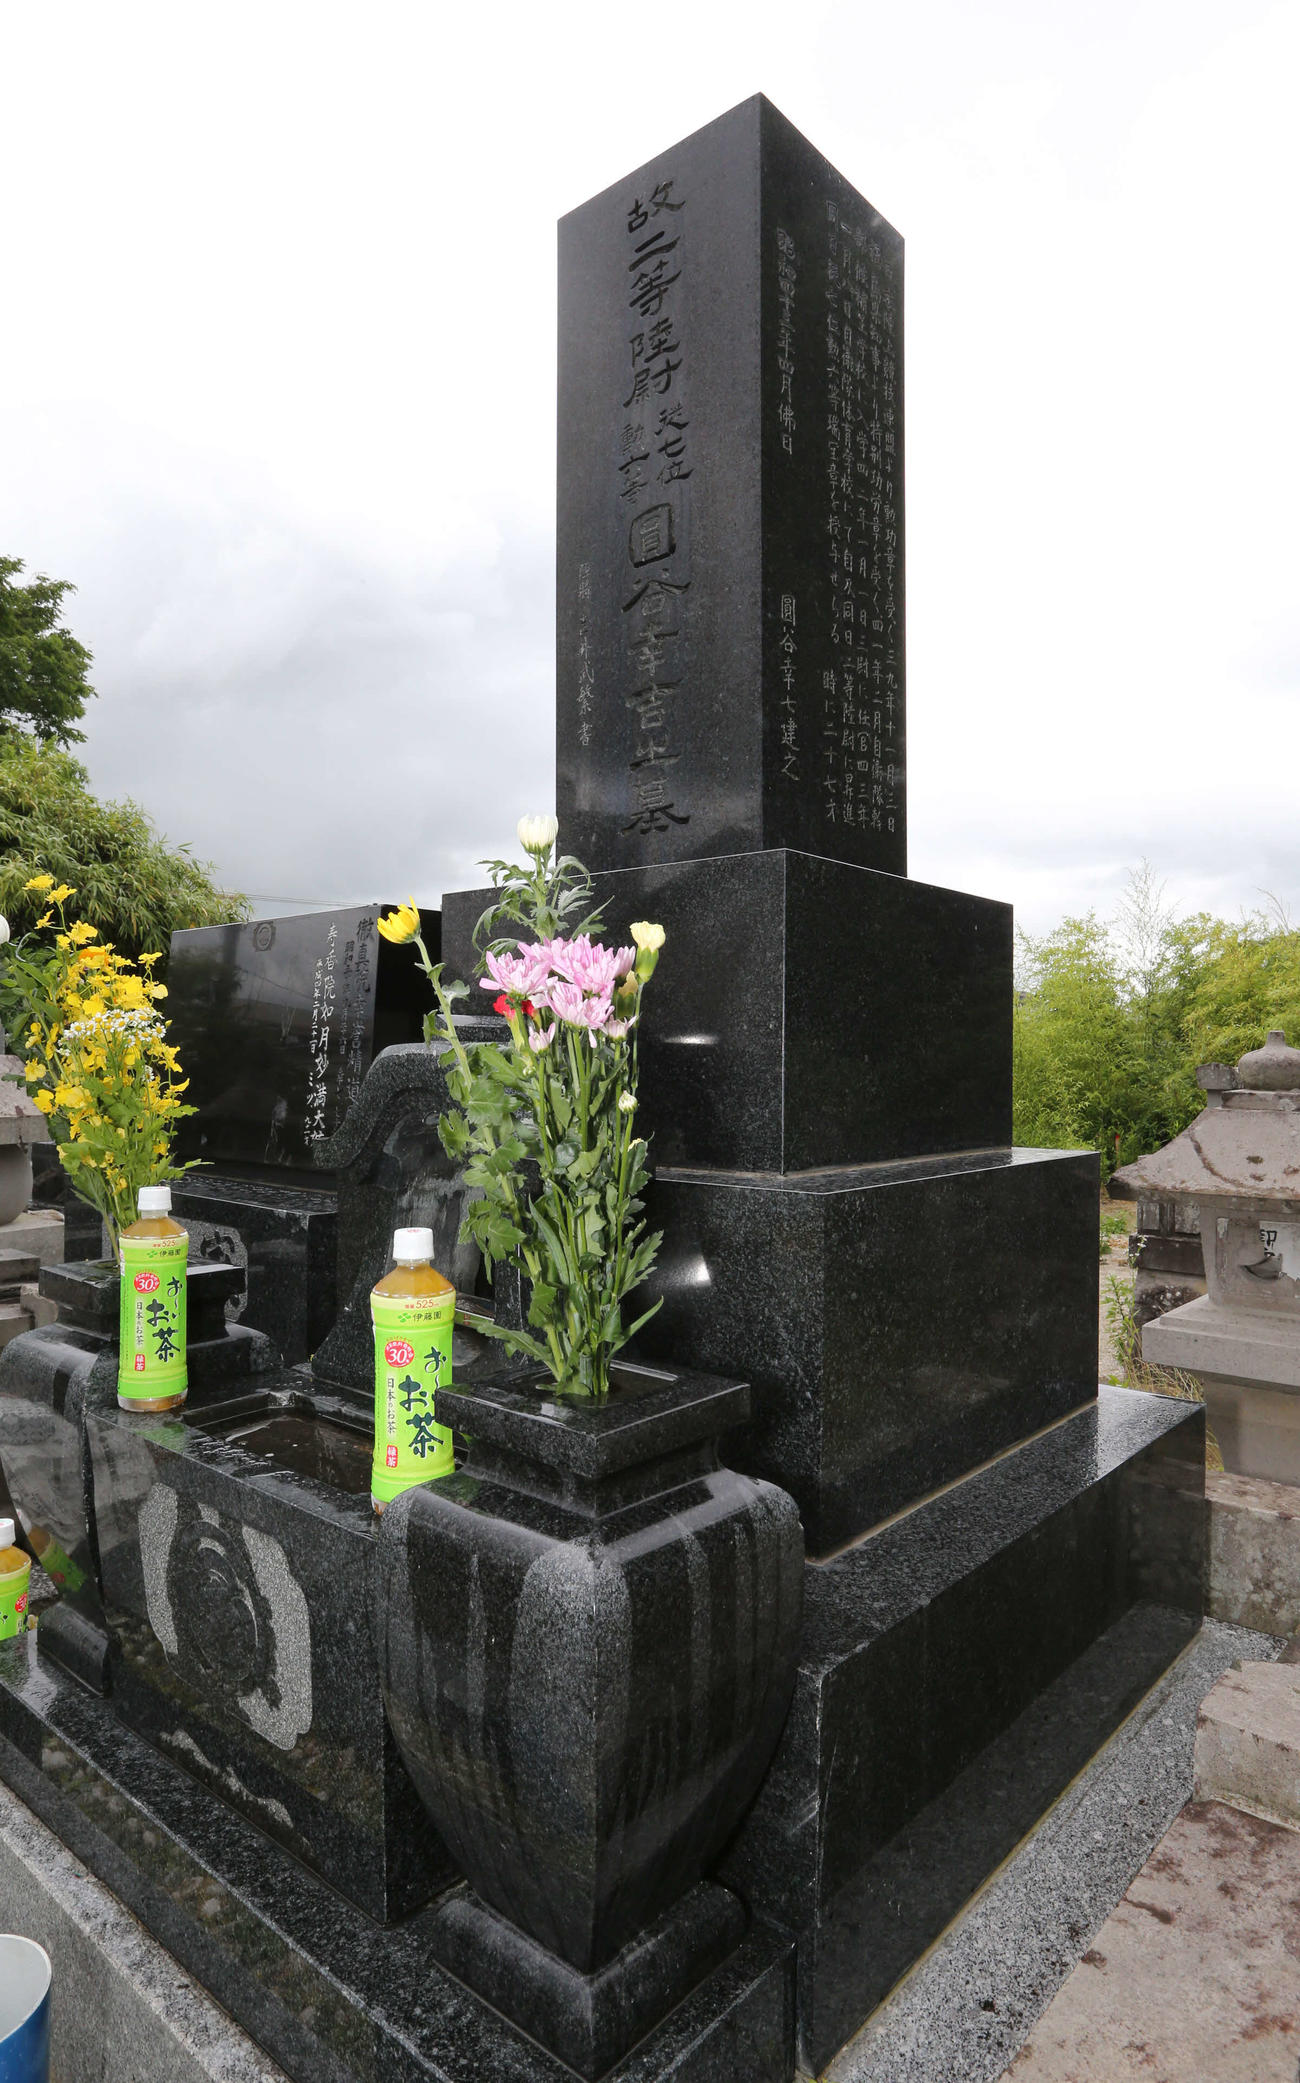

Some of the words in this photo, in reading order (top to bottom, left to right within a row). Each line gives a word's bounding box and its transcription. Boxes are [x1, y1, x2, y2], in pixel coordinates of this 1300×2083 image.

[623, 180, 687, 410] 故二等陸尉
[619, 501, 692, 836] 圓谷幸吉之墓
[146, 1298, 181, 1363] お茶
[412, 1311, 442, 1322] 伊藤園
[397, 1373, 445, 1459] お茶
